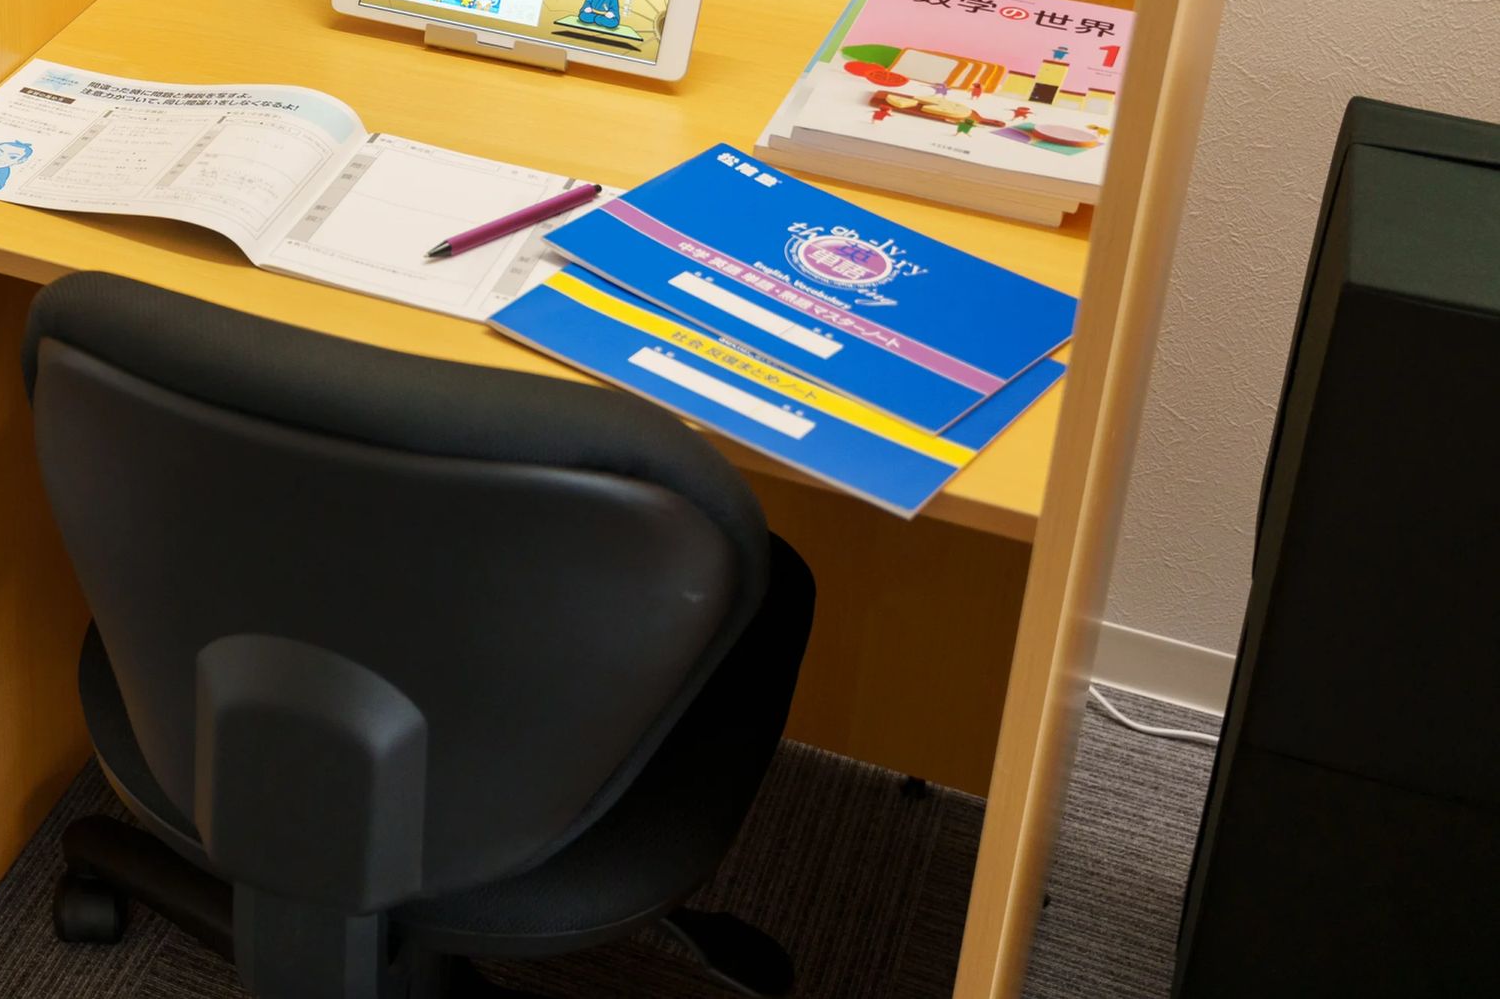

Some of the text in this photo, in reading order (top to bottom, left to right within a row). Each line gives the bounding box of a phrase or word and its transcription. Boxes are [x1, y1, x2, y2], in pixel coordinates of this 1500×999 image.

[1098, 45, 1121, 68] 1
[678, 240, 710, 261] 中学
[809, 249, 867, 279] 単語
[793, 279, 852, 311] Vocabulary
